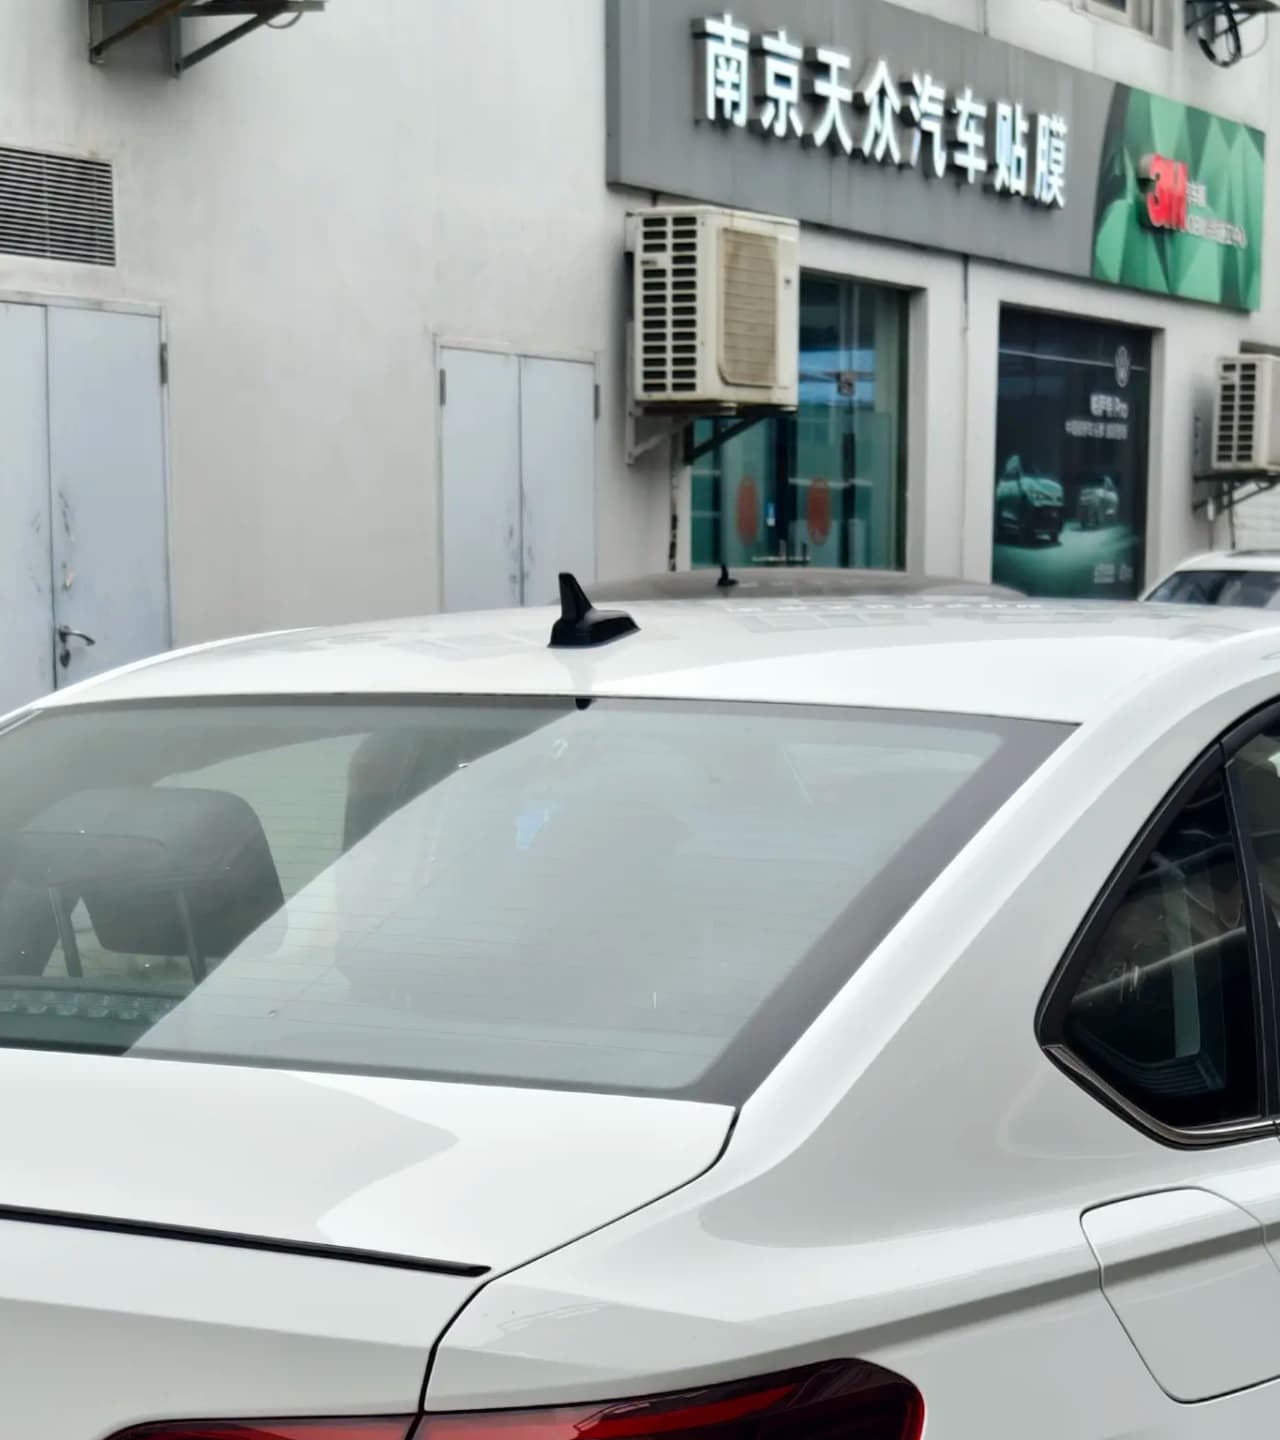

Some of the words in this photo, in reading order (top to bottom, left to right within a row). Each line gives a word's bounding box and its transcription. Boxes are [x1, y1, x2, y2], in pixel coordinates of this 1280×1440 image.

[703, 13, 1068, 209] 南京天众汽车贴膜
[1145, 152, 1188, 231] 3M
